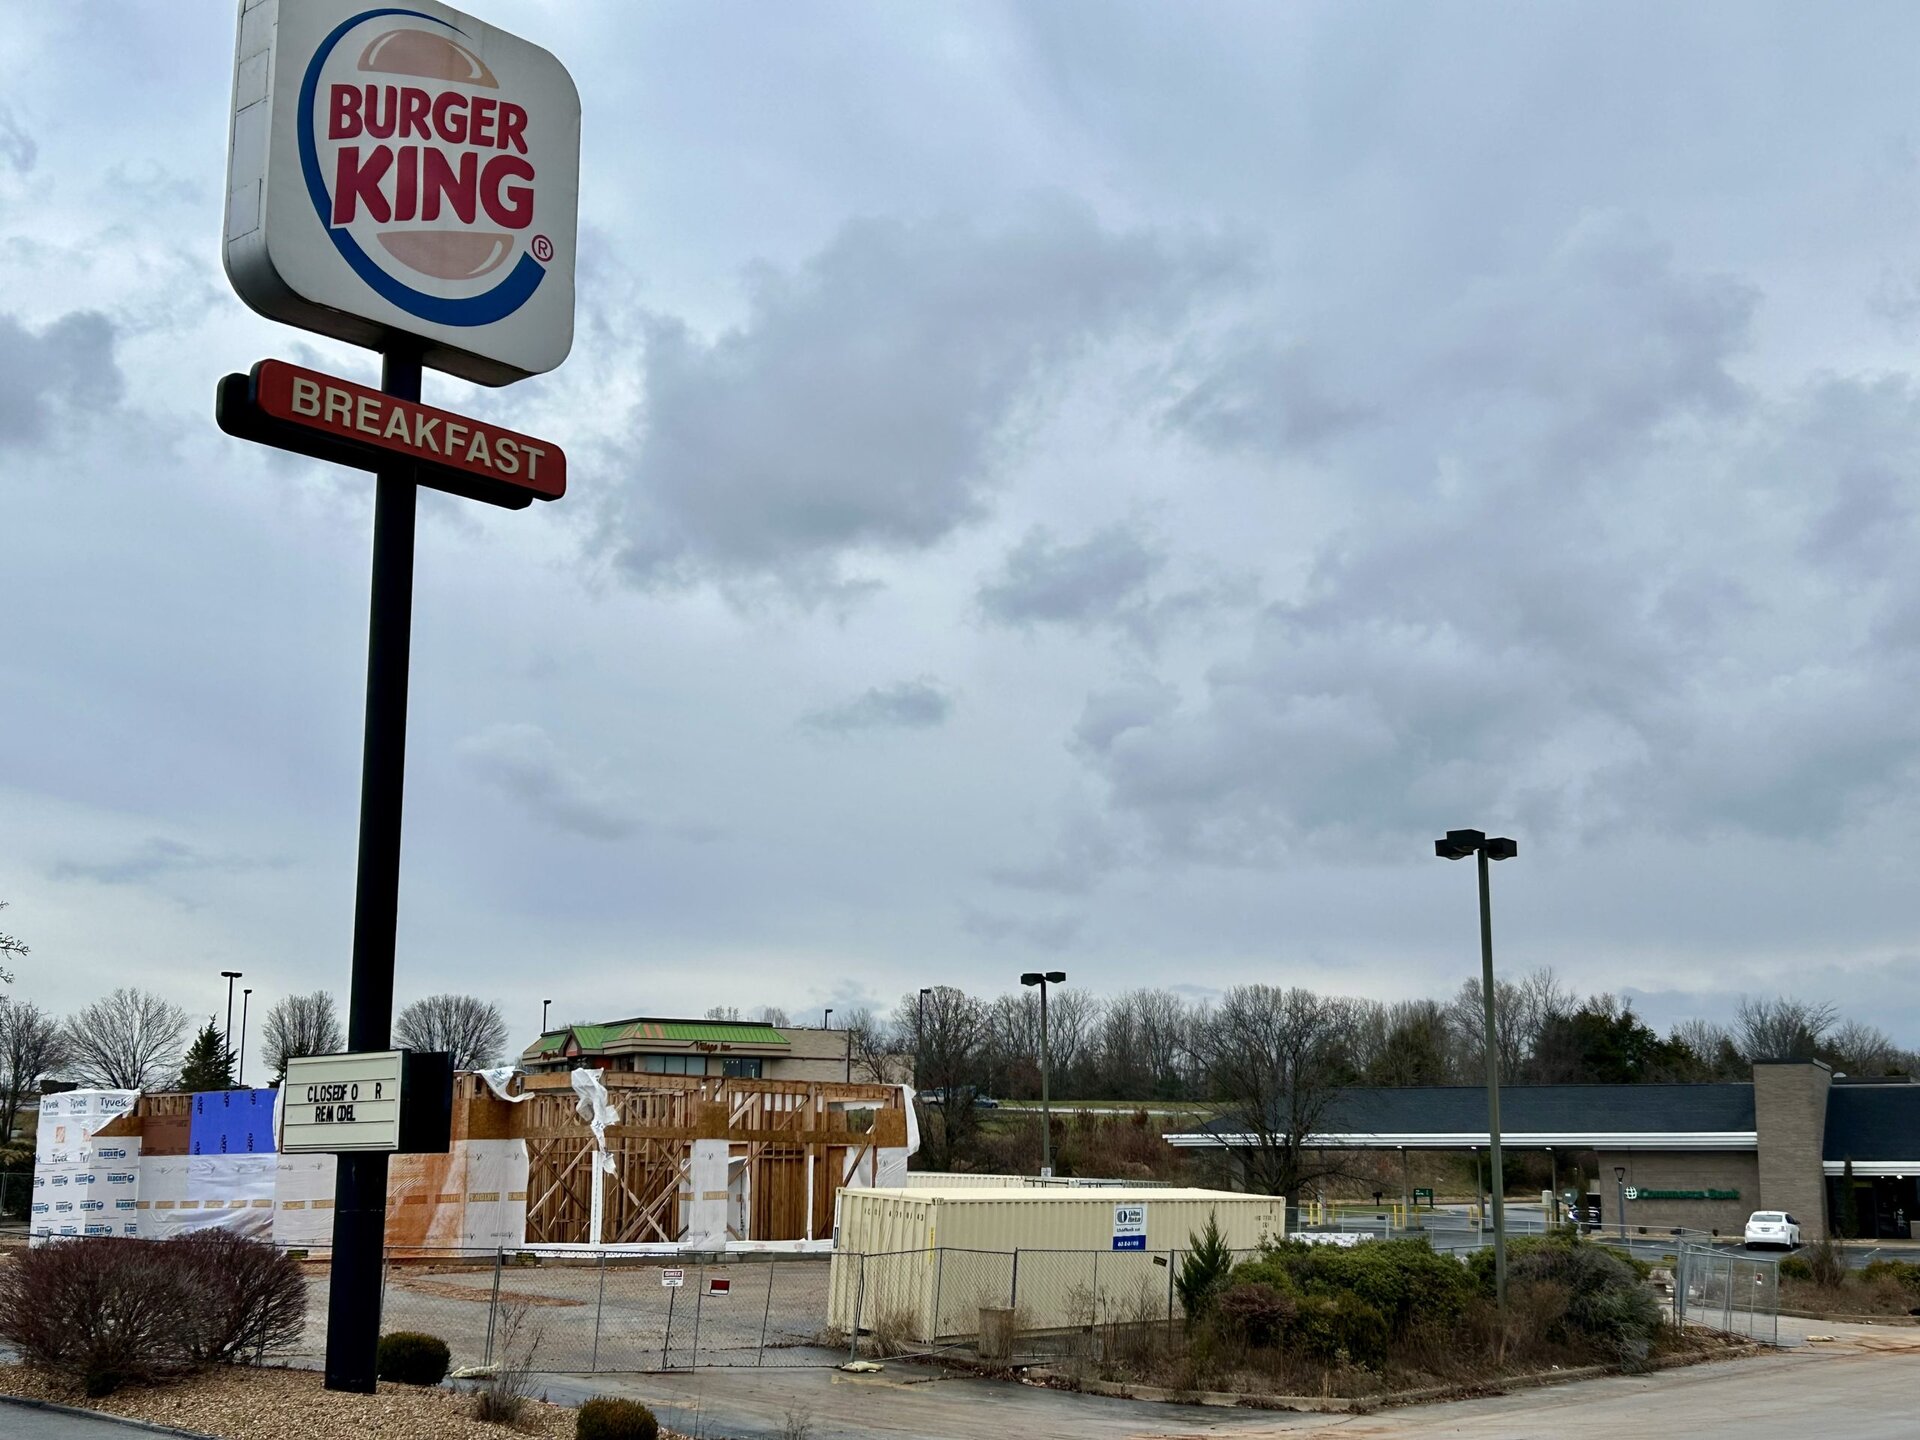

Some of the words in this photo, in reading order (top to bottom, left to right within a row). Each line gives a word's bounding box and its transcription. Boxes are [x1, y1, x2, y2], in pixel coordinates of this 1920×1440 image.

[329, 84, 529, 154] BURGER
[333, 145, 536, 230] KING
[291, 377, 546, 481] BREAKFAST
[100, 1096, 128, 1109] Tyvek
